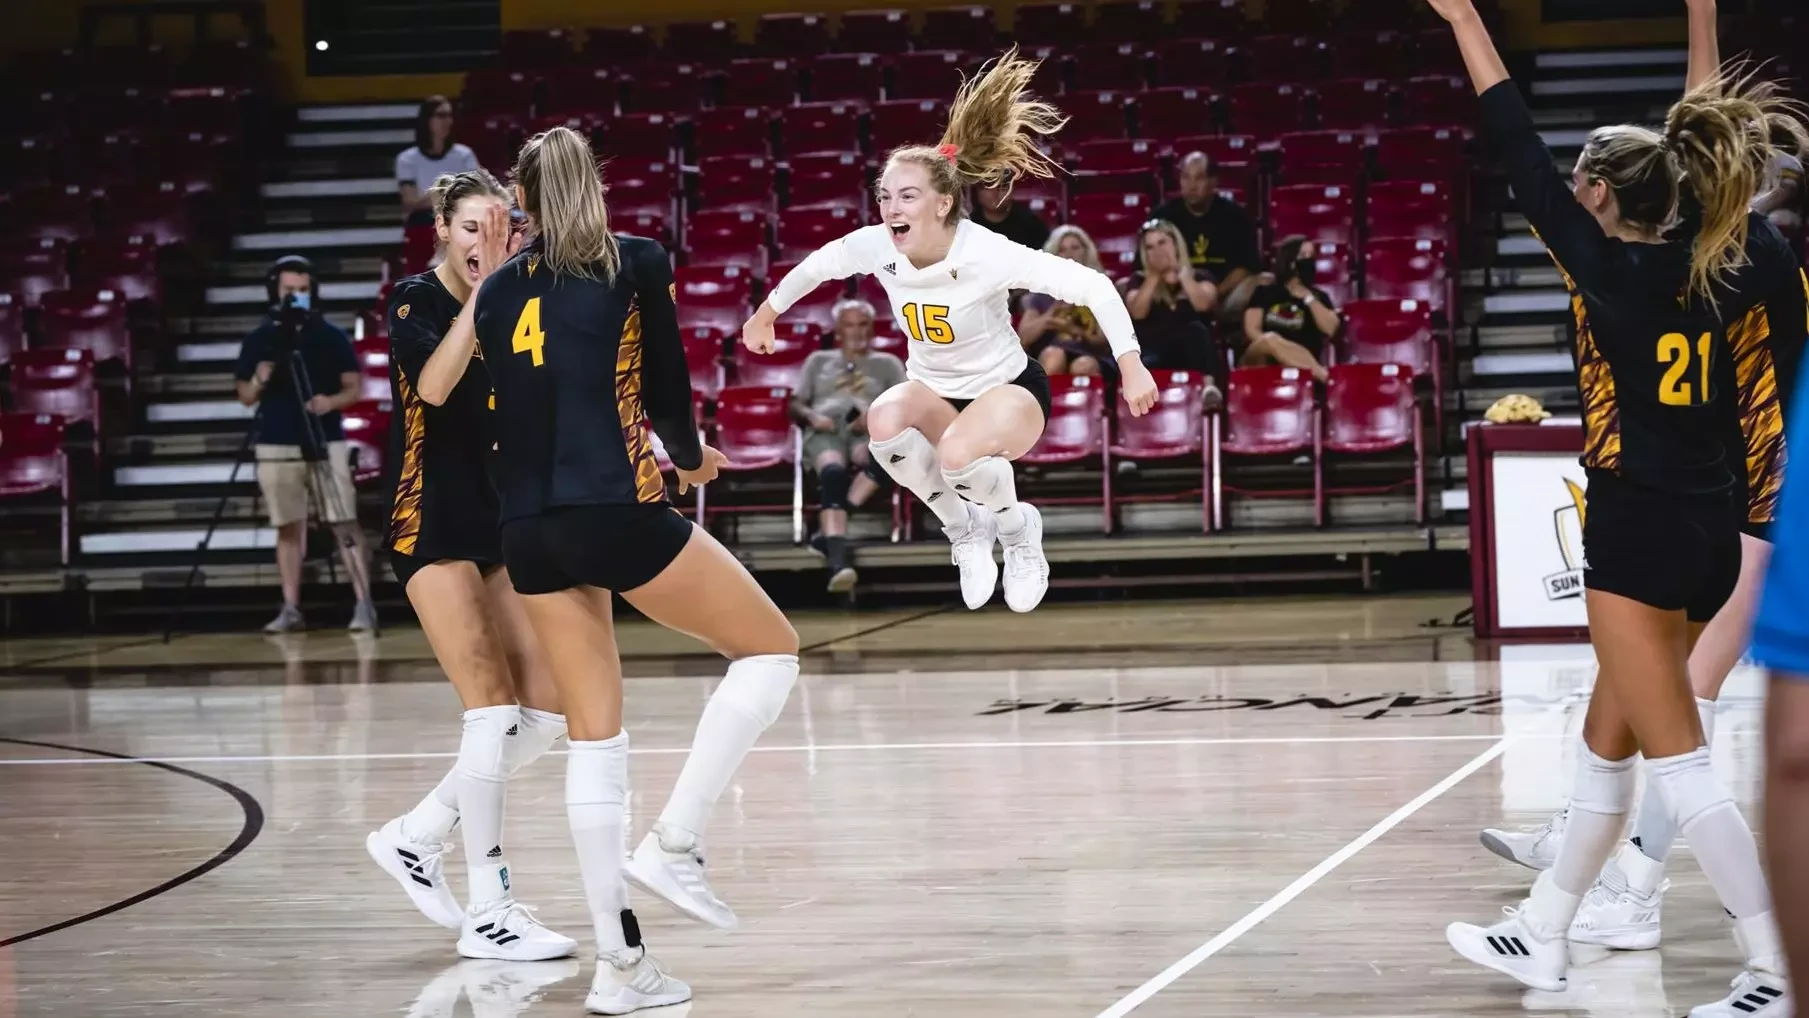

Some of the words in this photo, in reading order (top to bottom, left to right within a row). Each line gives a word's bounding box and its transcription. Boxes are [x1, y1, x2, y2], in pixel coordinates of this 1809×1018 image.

[511, 296, 546, 367] 4
[902, 302, 955, 344] 15
[1657, 331, 1711, 405] 21
[1551, 575, 1580, 592] SUN
